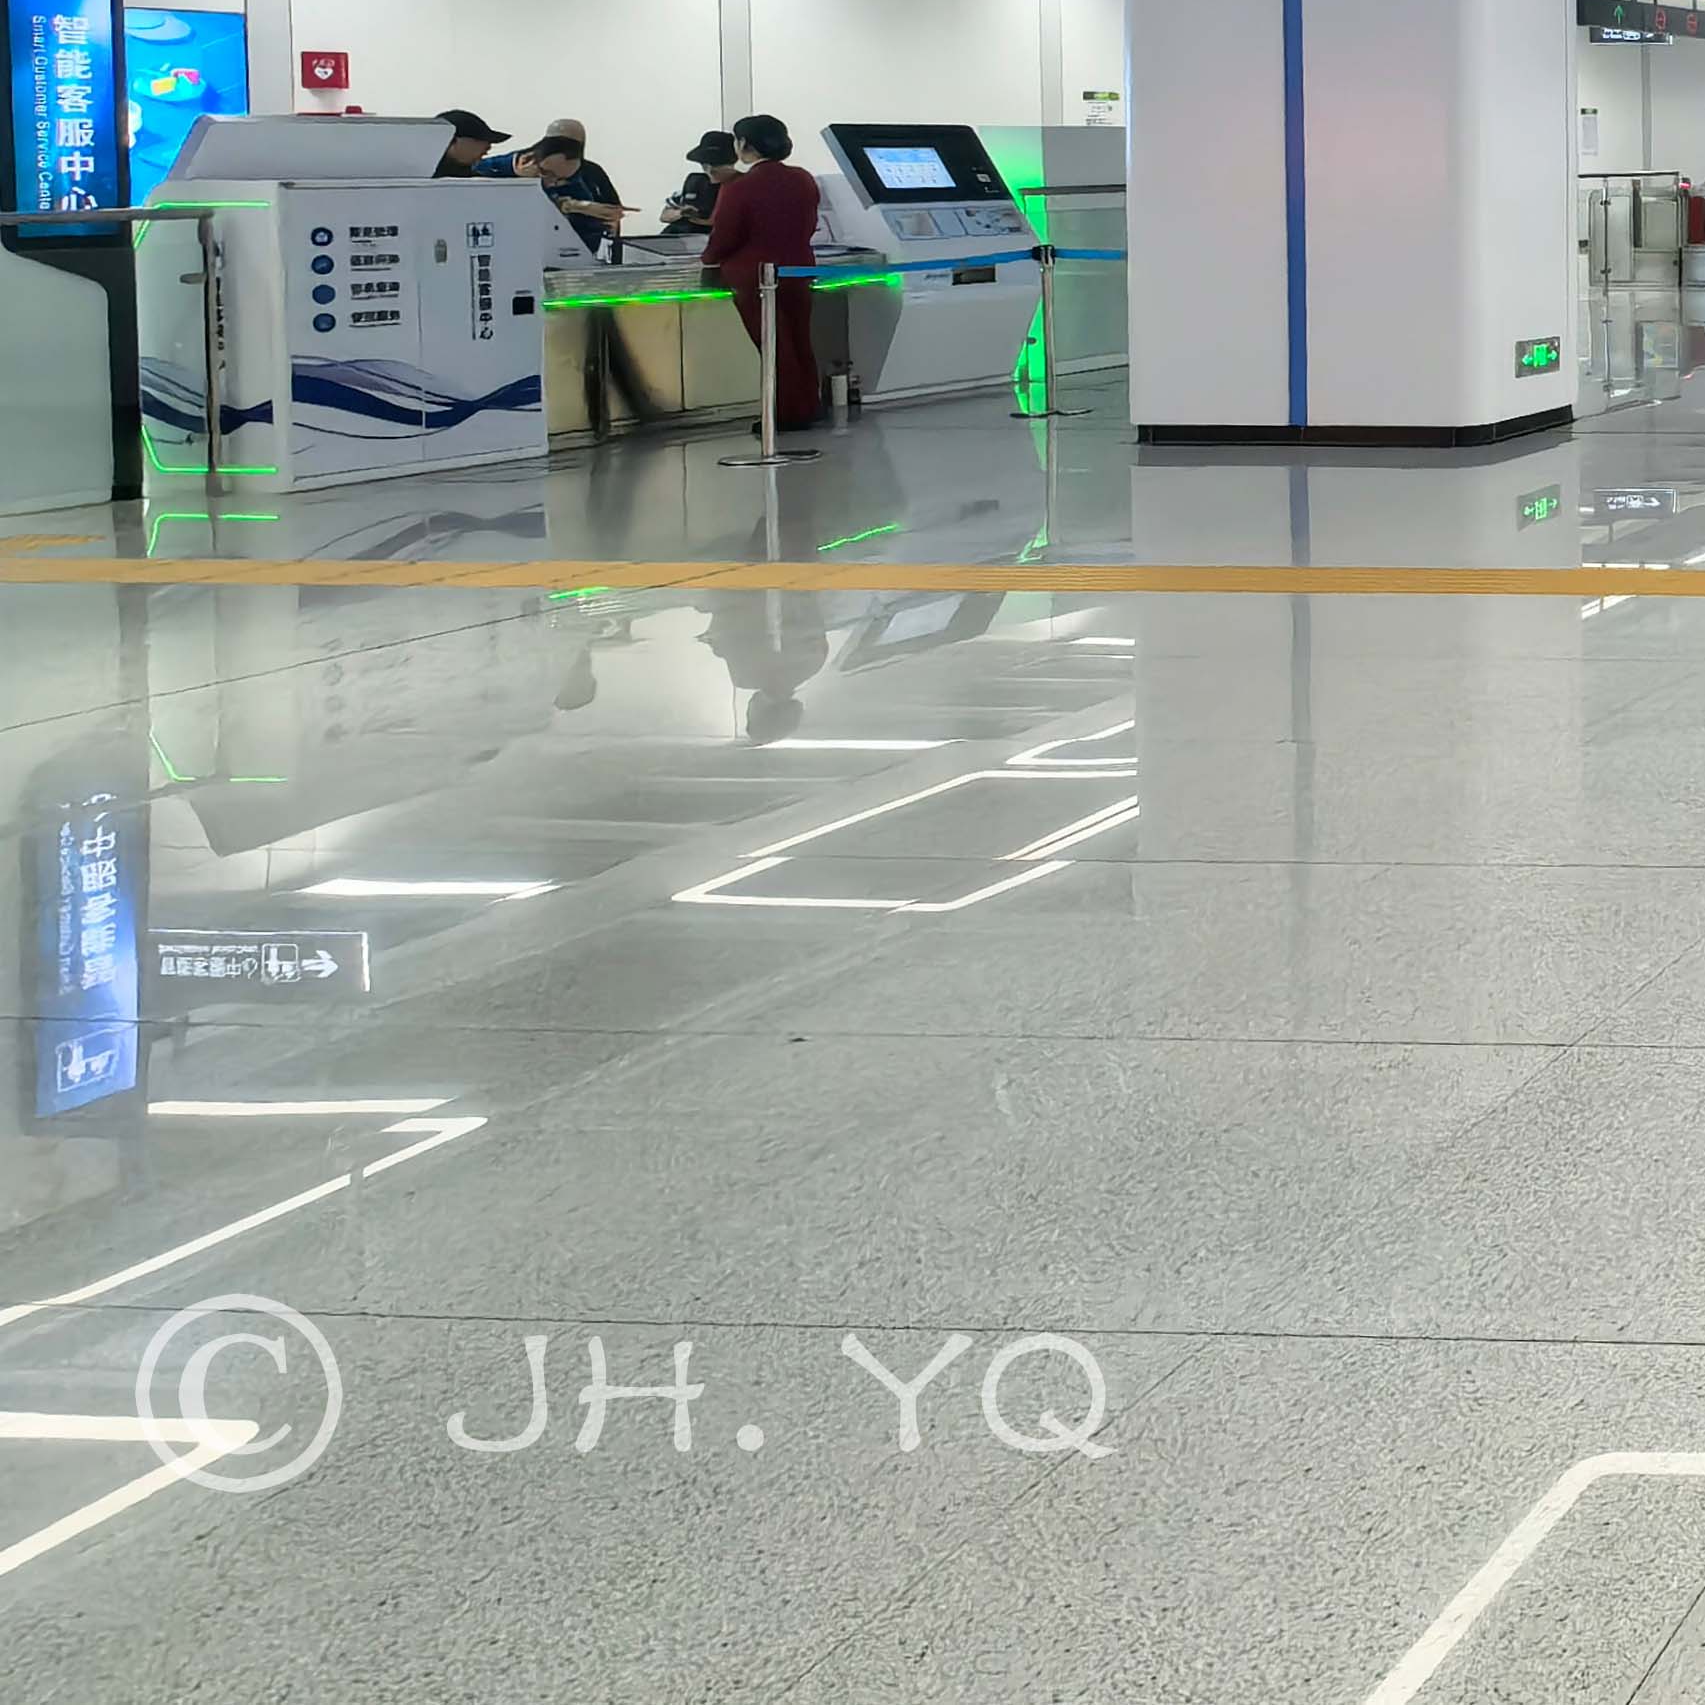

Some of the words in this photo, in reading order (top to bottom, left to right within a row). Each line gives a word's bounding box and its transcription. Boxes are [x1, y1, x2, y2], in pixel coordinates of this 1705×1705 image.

[53, 14, 98, 211] 智能客服中心
